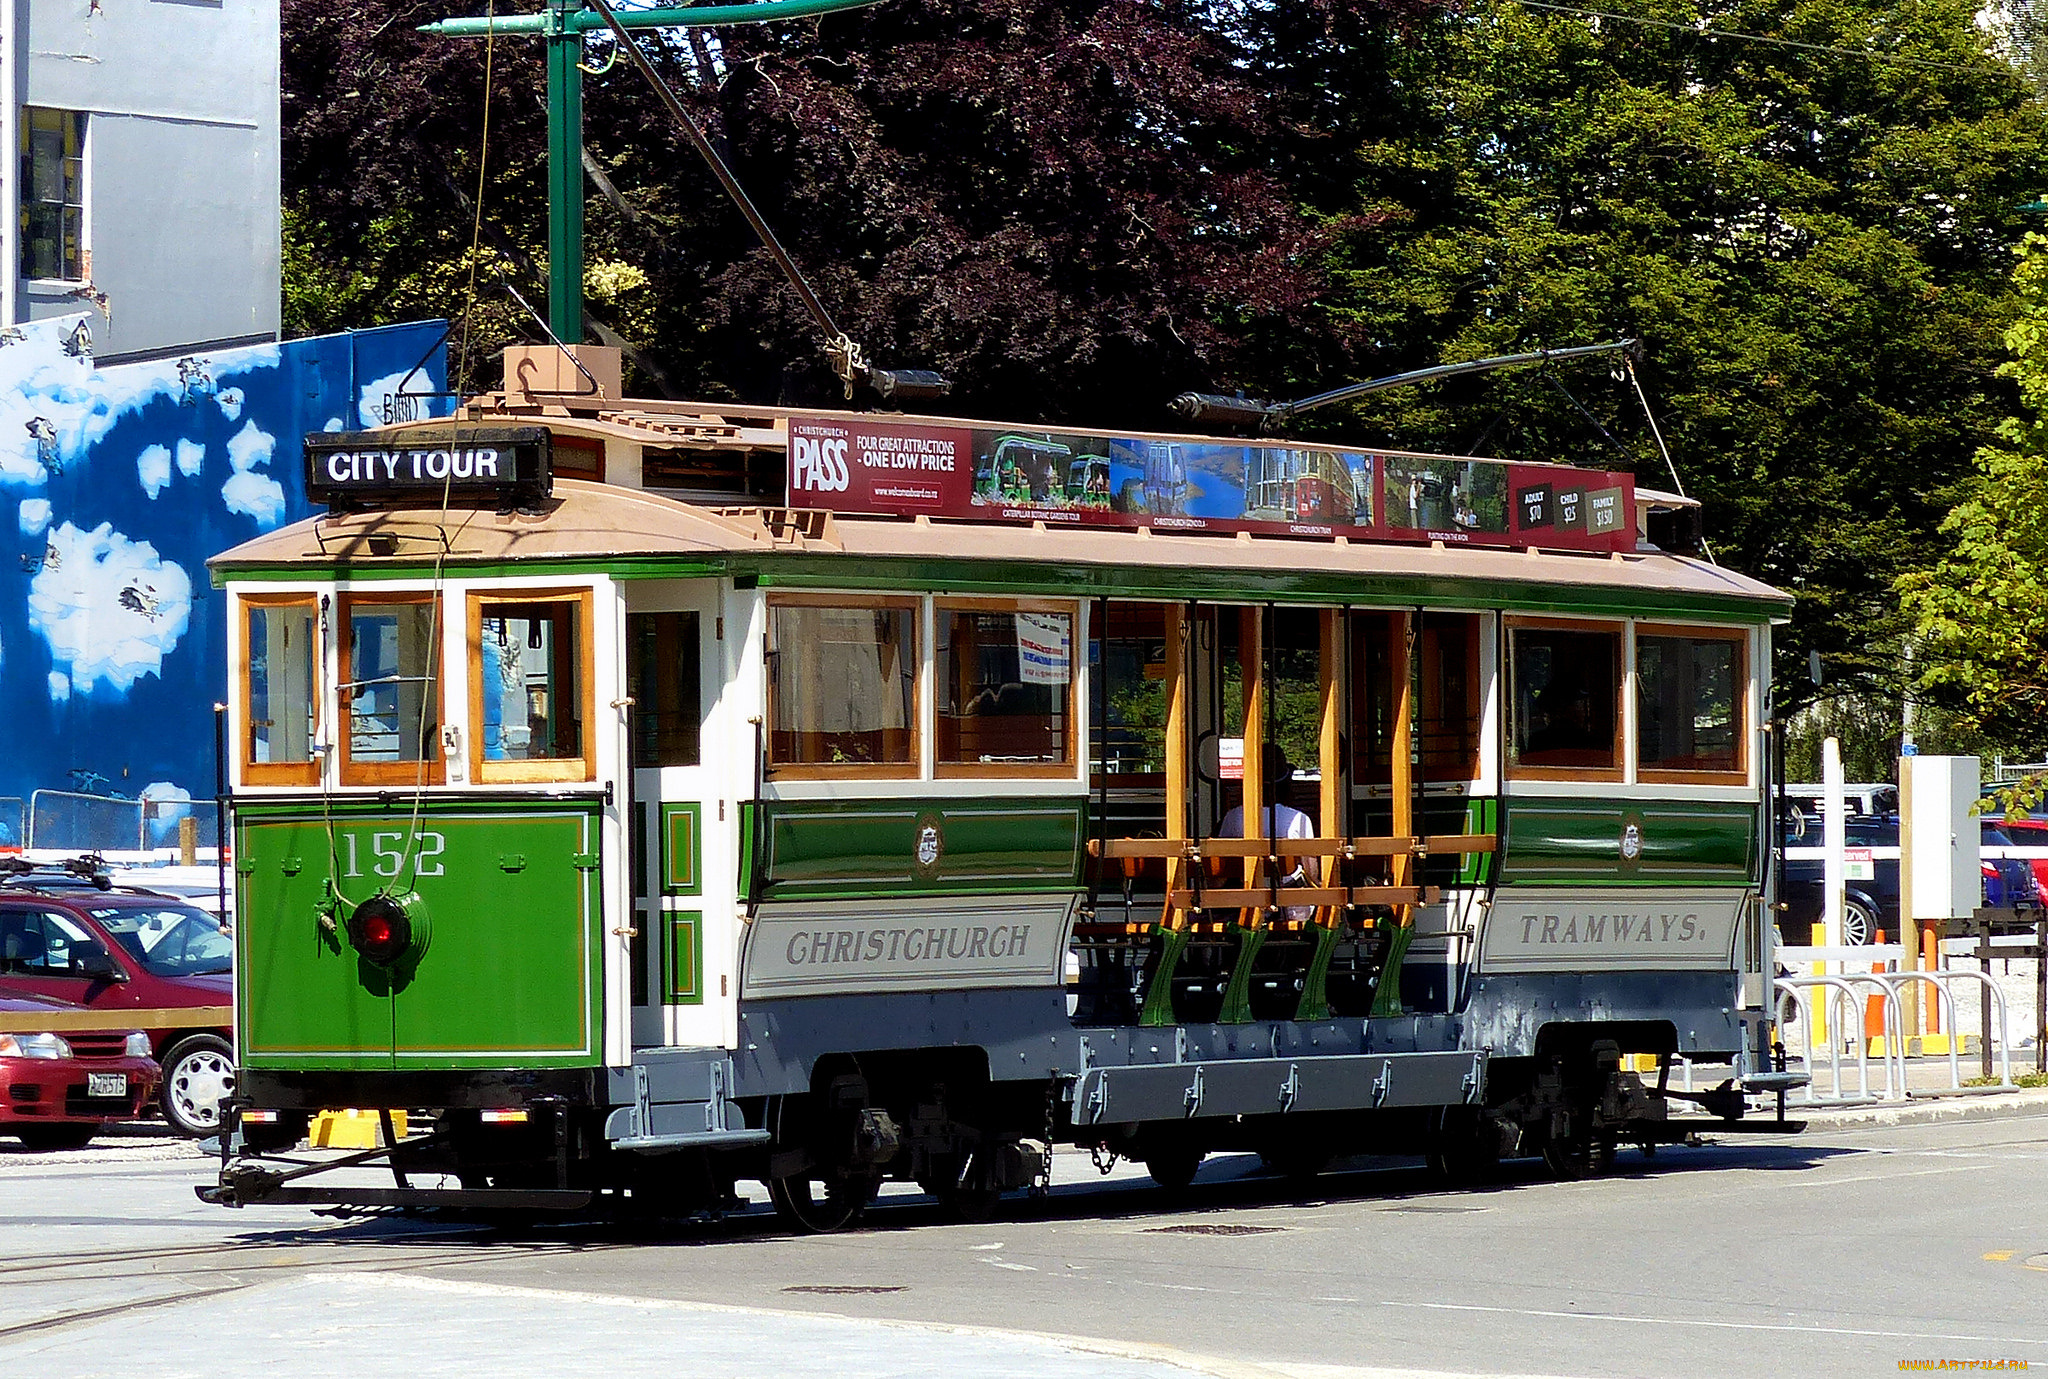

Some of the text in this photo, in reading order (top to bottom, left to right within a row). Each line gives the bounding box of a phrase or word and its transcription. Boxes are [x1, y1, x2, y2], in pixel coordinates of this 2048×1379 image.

[798, 426, 844, 437] CHRISTCHURCH
[857, 436, 955, 455] FOUR GREAT ATTRACTIONS
[328, 448, 499, 482] CITY TOUR
[793, 436, 850, 492] PASS
[863, 450, 890, 468] ONE
[891, 452, 919, 470] LOW
[921, 454, 955, 472] PRICE
[1524, 491, 1544, 504] ADULT
[1560, 493, 1578, 505] CHILD
[1592, 496, 1614, 509] FAMILY
[1529, 504, 1542, 523] $70
[1564, 506, 1576, 524] $25
[1596, 509, 1613, 527] $150
[341, 831, 446, 877] 152
[1520, 913, 1706, 943] TRAMWAYS.
[786, 924, 1031, 965] CHRISTCHURCH
